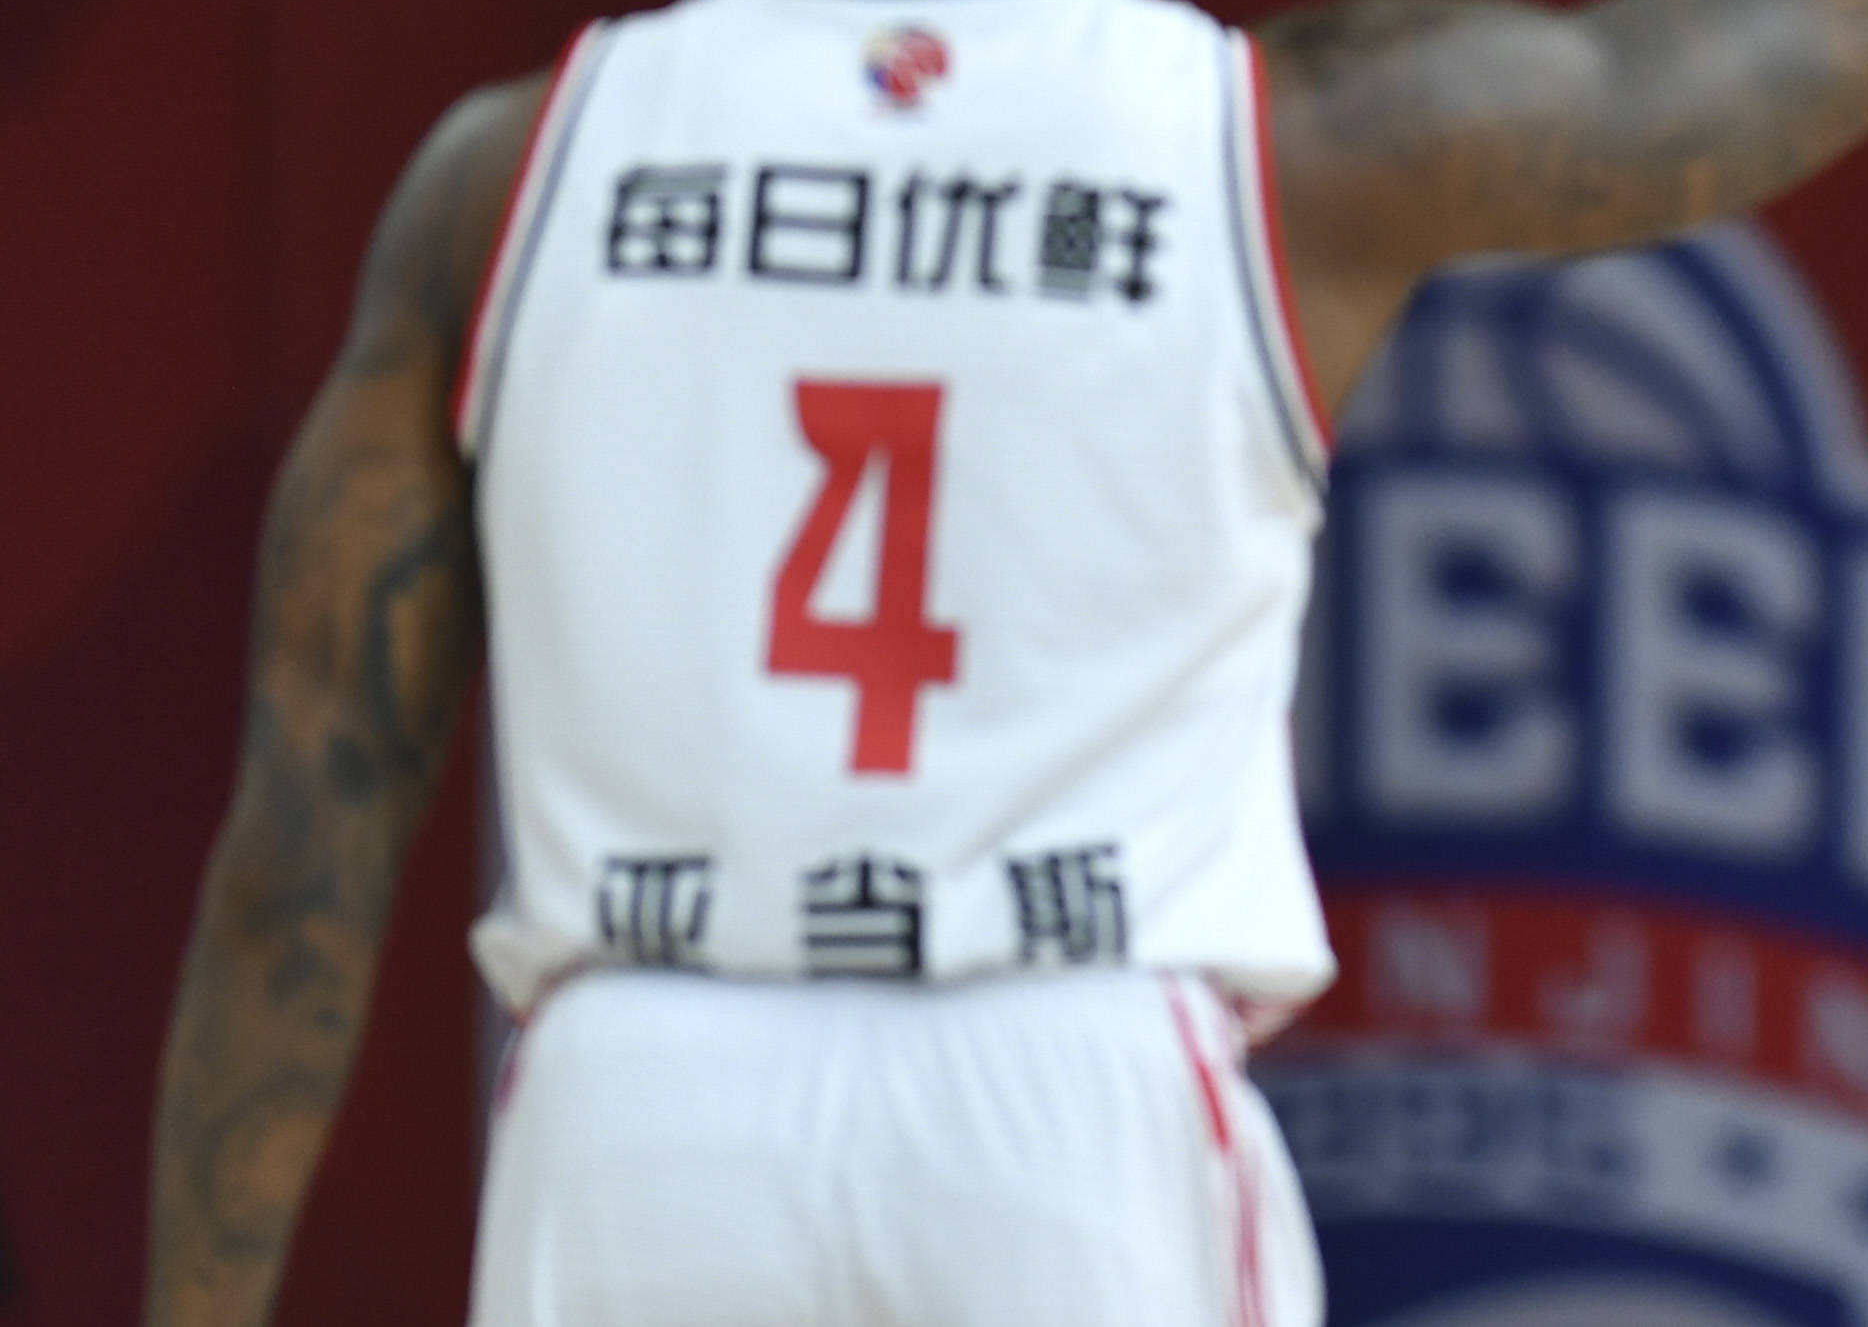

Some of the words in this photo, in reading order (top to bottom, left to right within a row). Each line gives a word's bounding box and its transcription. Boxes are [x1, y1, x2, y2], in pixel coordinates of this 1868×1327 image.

[603, 160, 1171, 310] 每日优鲜
[764, 375, 964, 777] 4
[599, 843, 1127, 979] 亚当斯
